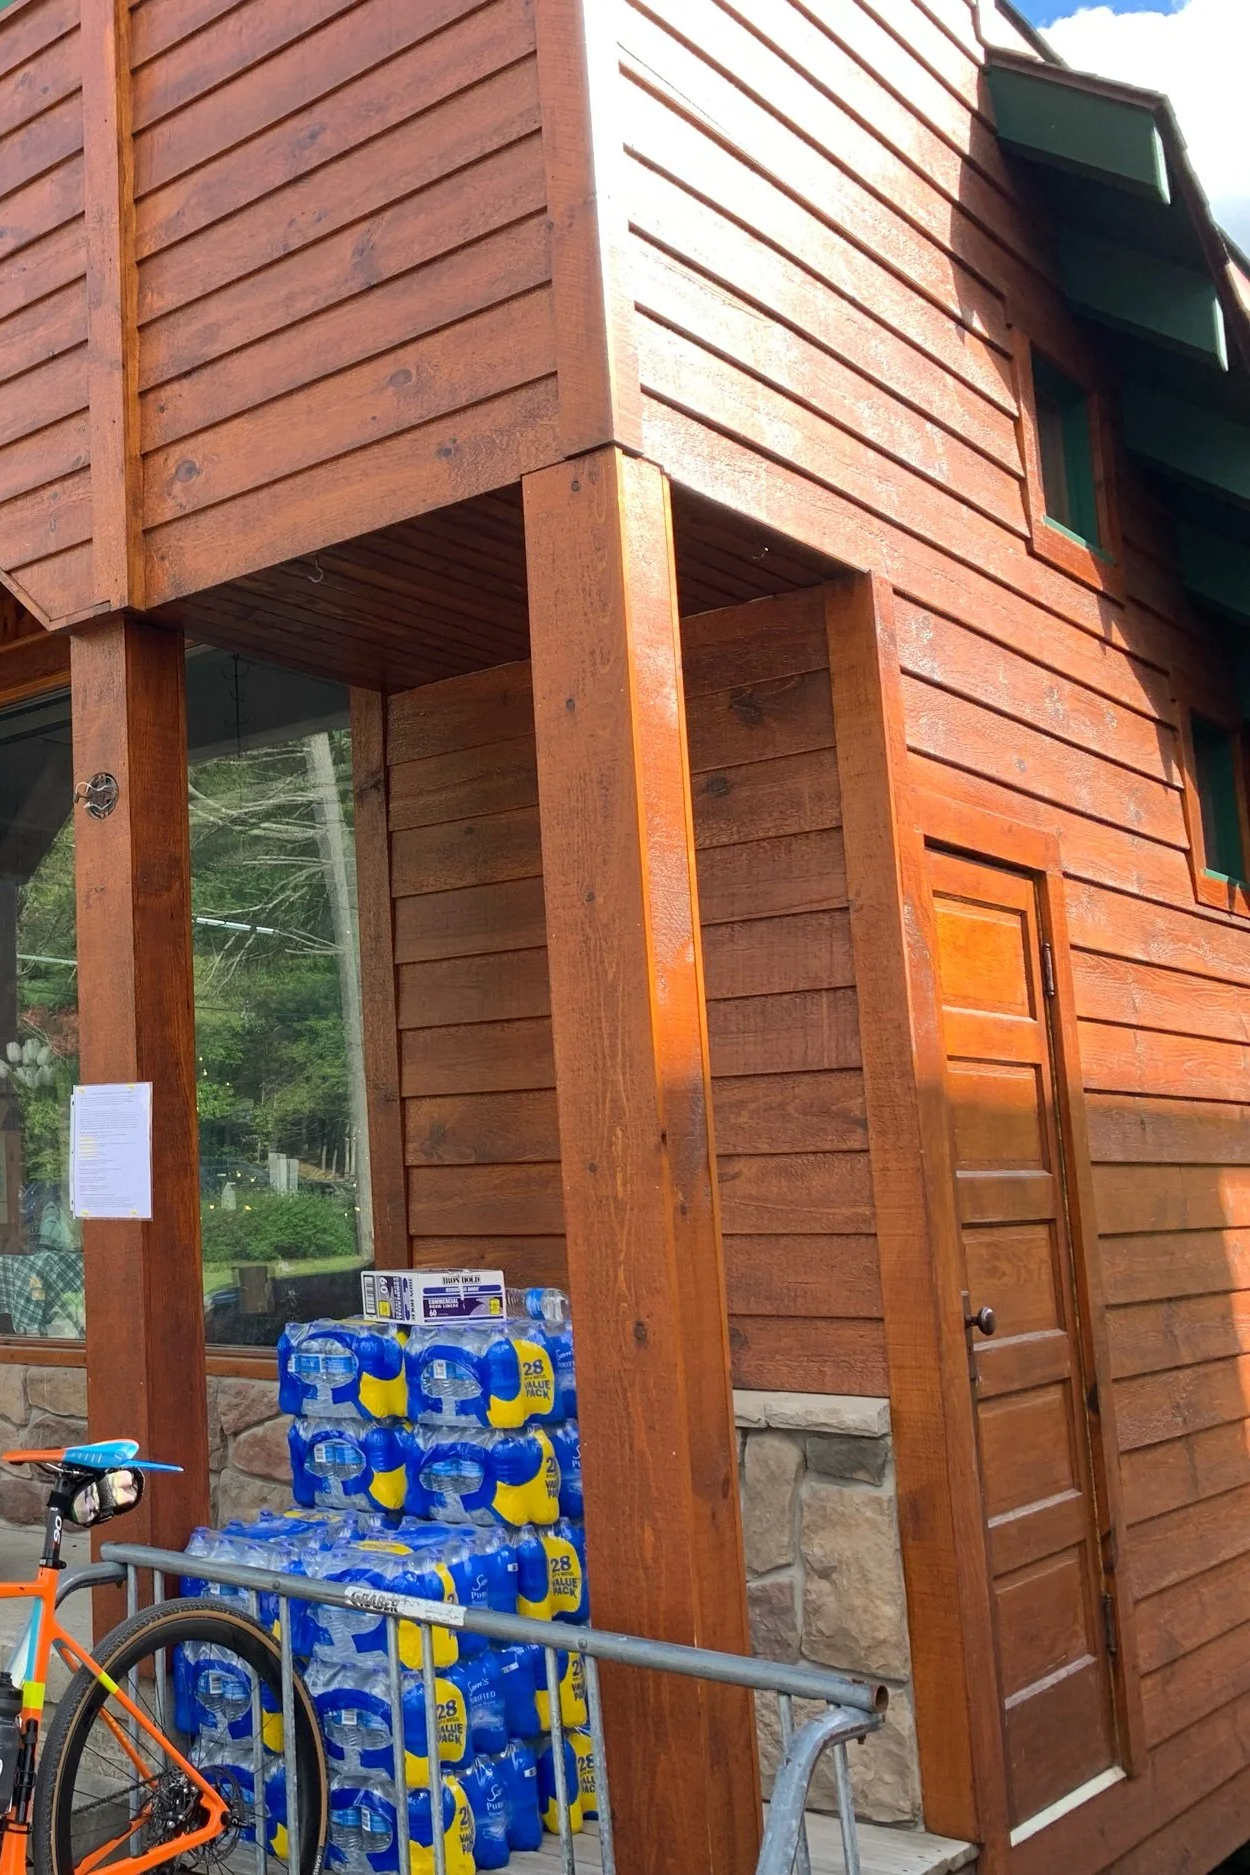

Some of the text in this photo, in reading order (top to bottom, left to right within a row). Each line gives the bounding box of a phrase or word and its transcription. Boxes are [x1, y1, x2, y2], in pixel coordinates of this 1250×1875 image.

[379, 1277, 388, 1294] 60
[429, 1309, 437, 1317] 60
[523, 1359, 544, 1376] 28
[524, 1380, 551, 1390] VALUE
[526, 1388, 550, 1400] PACK
[550, 1555, 571, 1573] 28
[552, 1578, 578, 1588] VALUE
[553, 1586, 577, 1599] PACK
[436, 1698, 457, 1720] 28
[578, 1753, 595, 1773] 28
[580, 1783, 596, 1796] PAC
